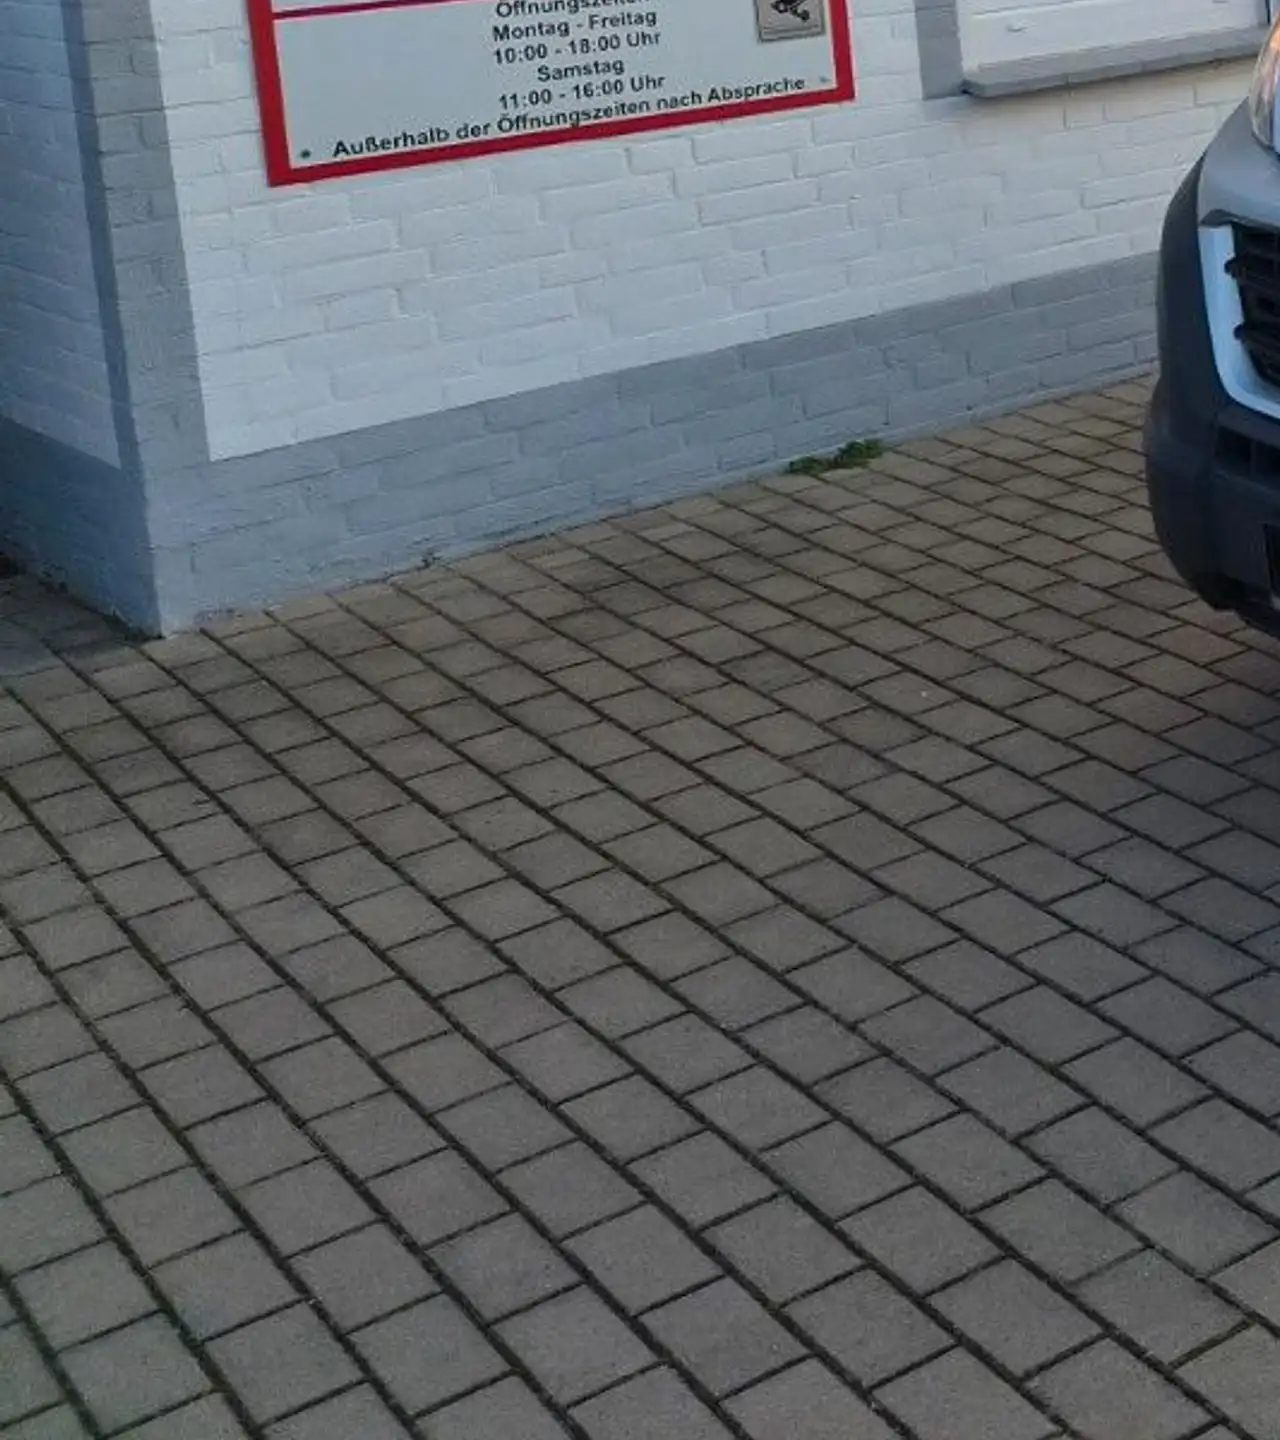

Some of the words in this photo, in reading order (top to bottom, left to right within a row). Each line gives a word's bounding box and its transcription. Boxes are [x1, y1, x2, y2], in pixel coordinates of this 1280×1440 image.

[493, 20, 570, 43] Montag
[588, 10, 658, 33] Freitag
[494, 44, 548, 65] 10:00
[569, 36, 621, 56] 18:00
[627, 29, 661, 48] Uhr
[537, 58, 625, 83] Samstag
[499, 89, 552, 111] 11:00
[572, 81, 624, 103] 16:00
[631, 74, 666, 93] Uhr
[332, 126, 450, 158] Außerhalb
[456, 122, 491, 140] der
[497, 97, 650, 133] Öffnungszeiten
[656, 90, 702, 111] nach
[707, 76, 806, 106] Absprache
